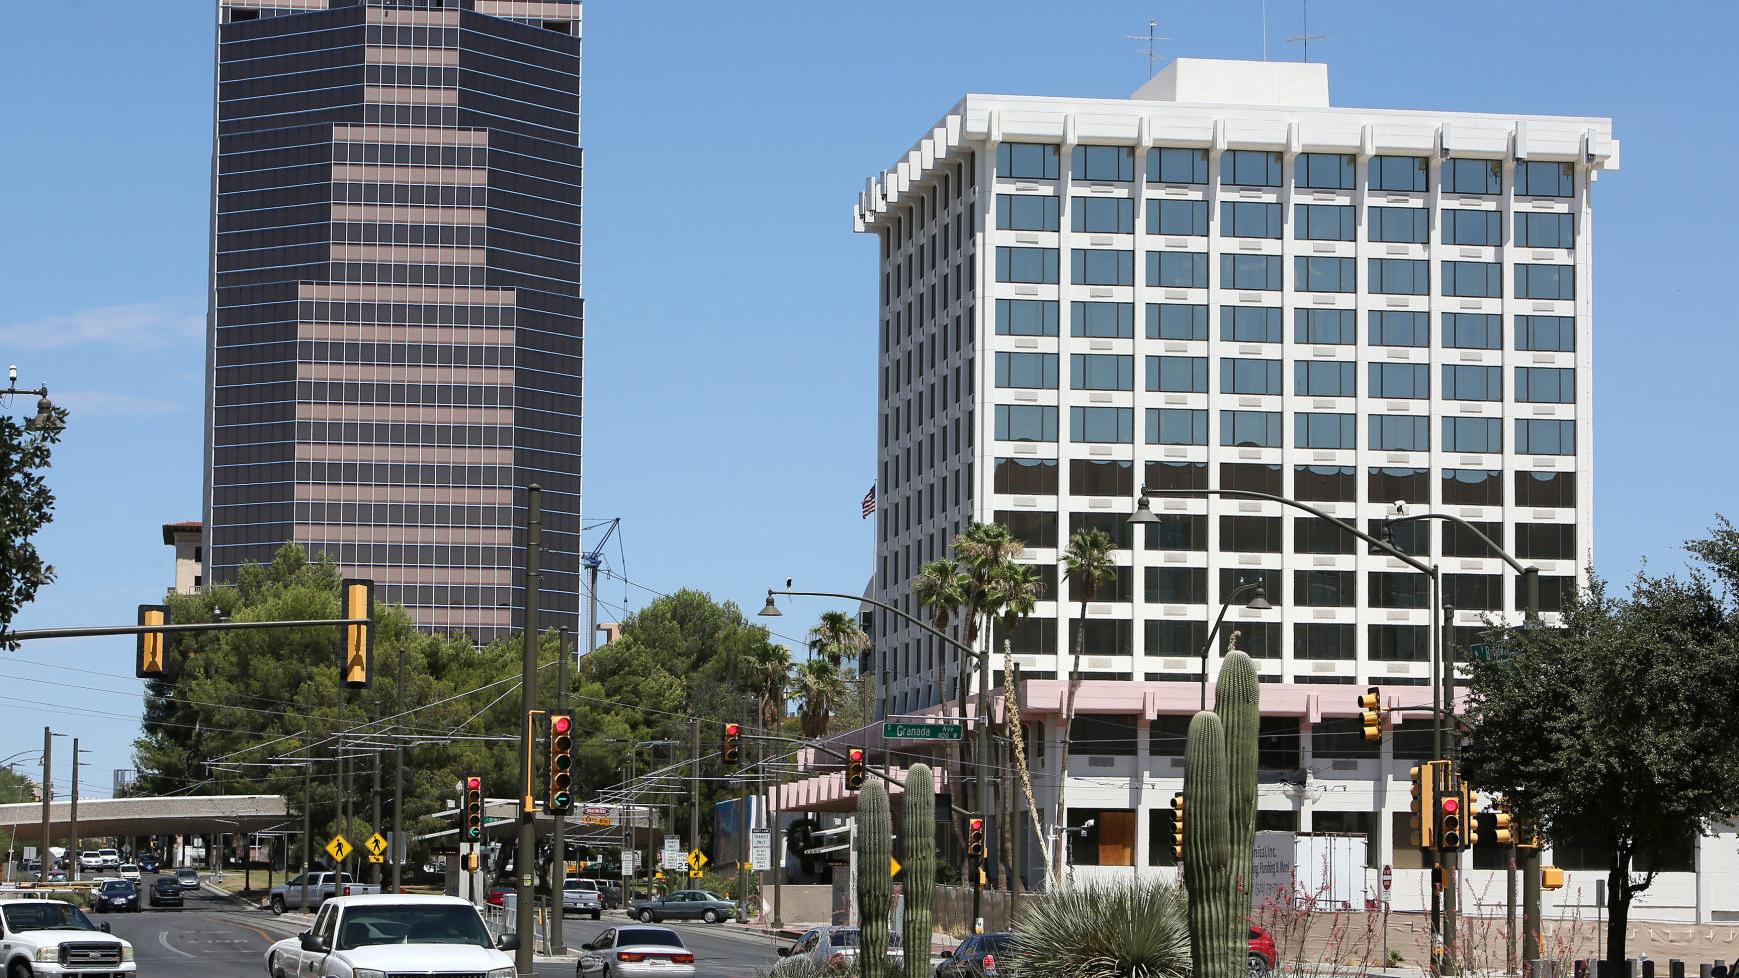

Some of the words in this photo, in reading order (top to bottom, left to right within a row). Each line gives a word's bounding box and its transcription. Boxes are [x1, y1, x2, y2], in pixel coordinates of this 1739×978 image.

[896, 725, 931, 737] Granada
[1268, 845, 1278, 858] Inc.
[1260, 860, 1276, 877] Plumbing
